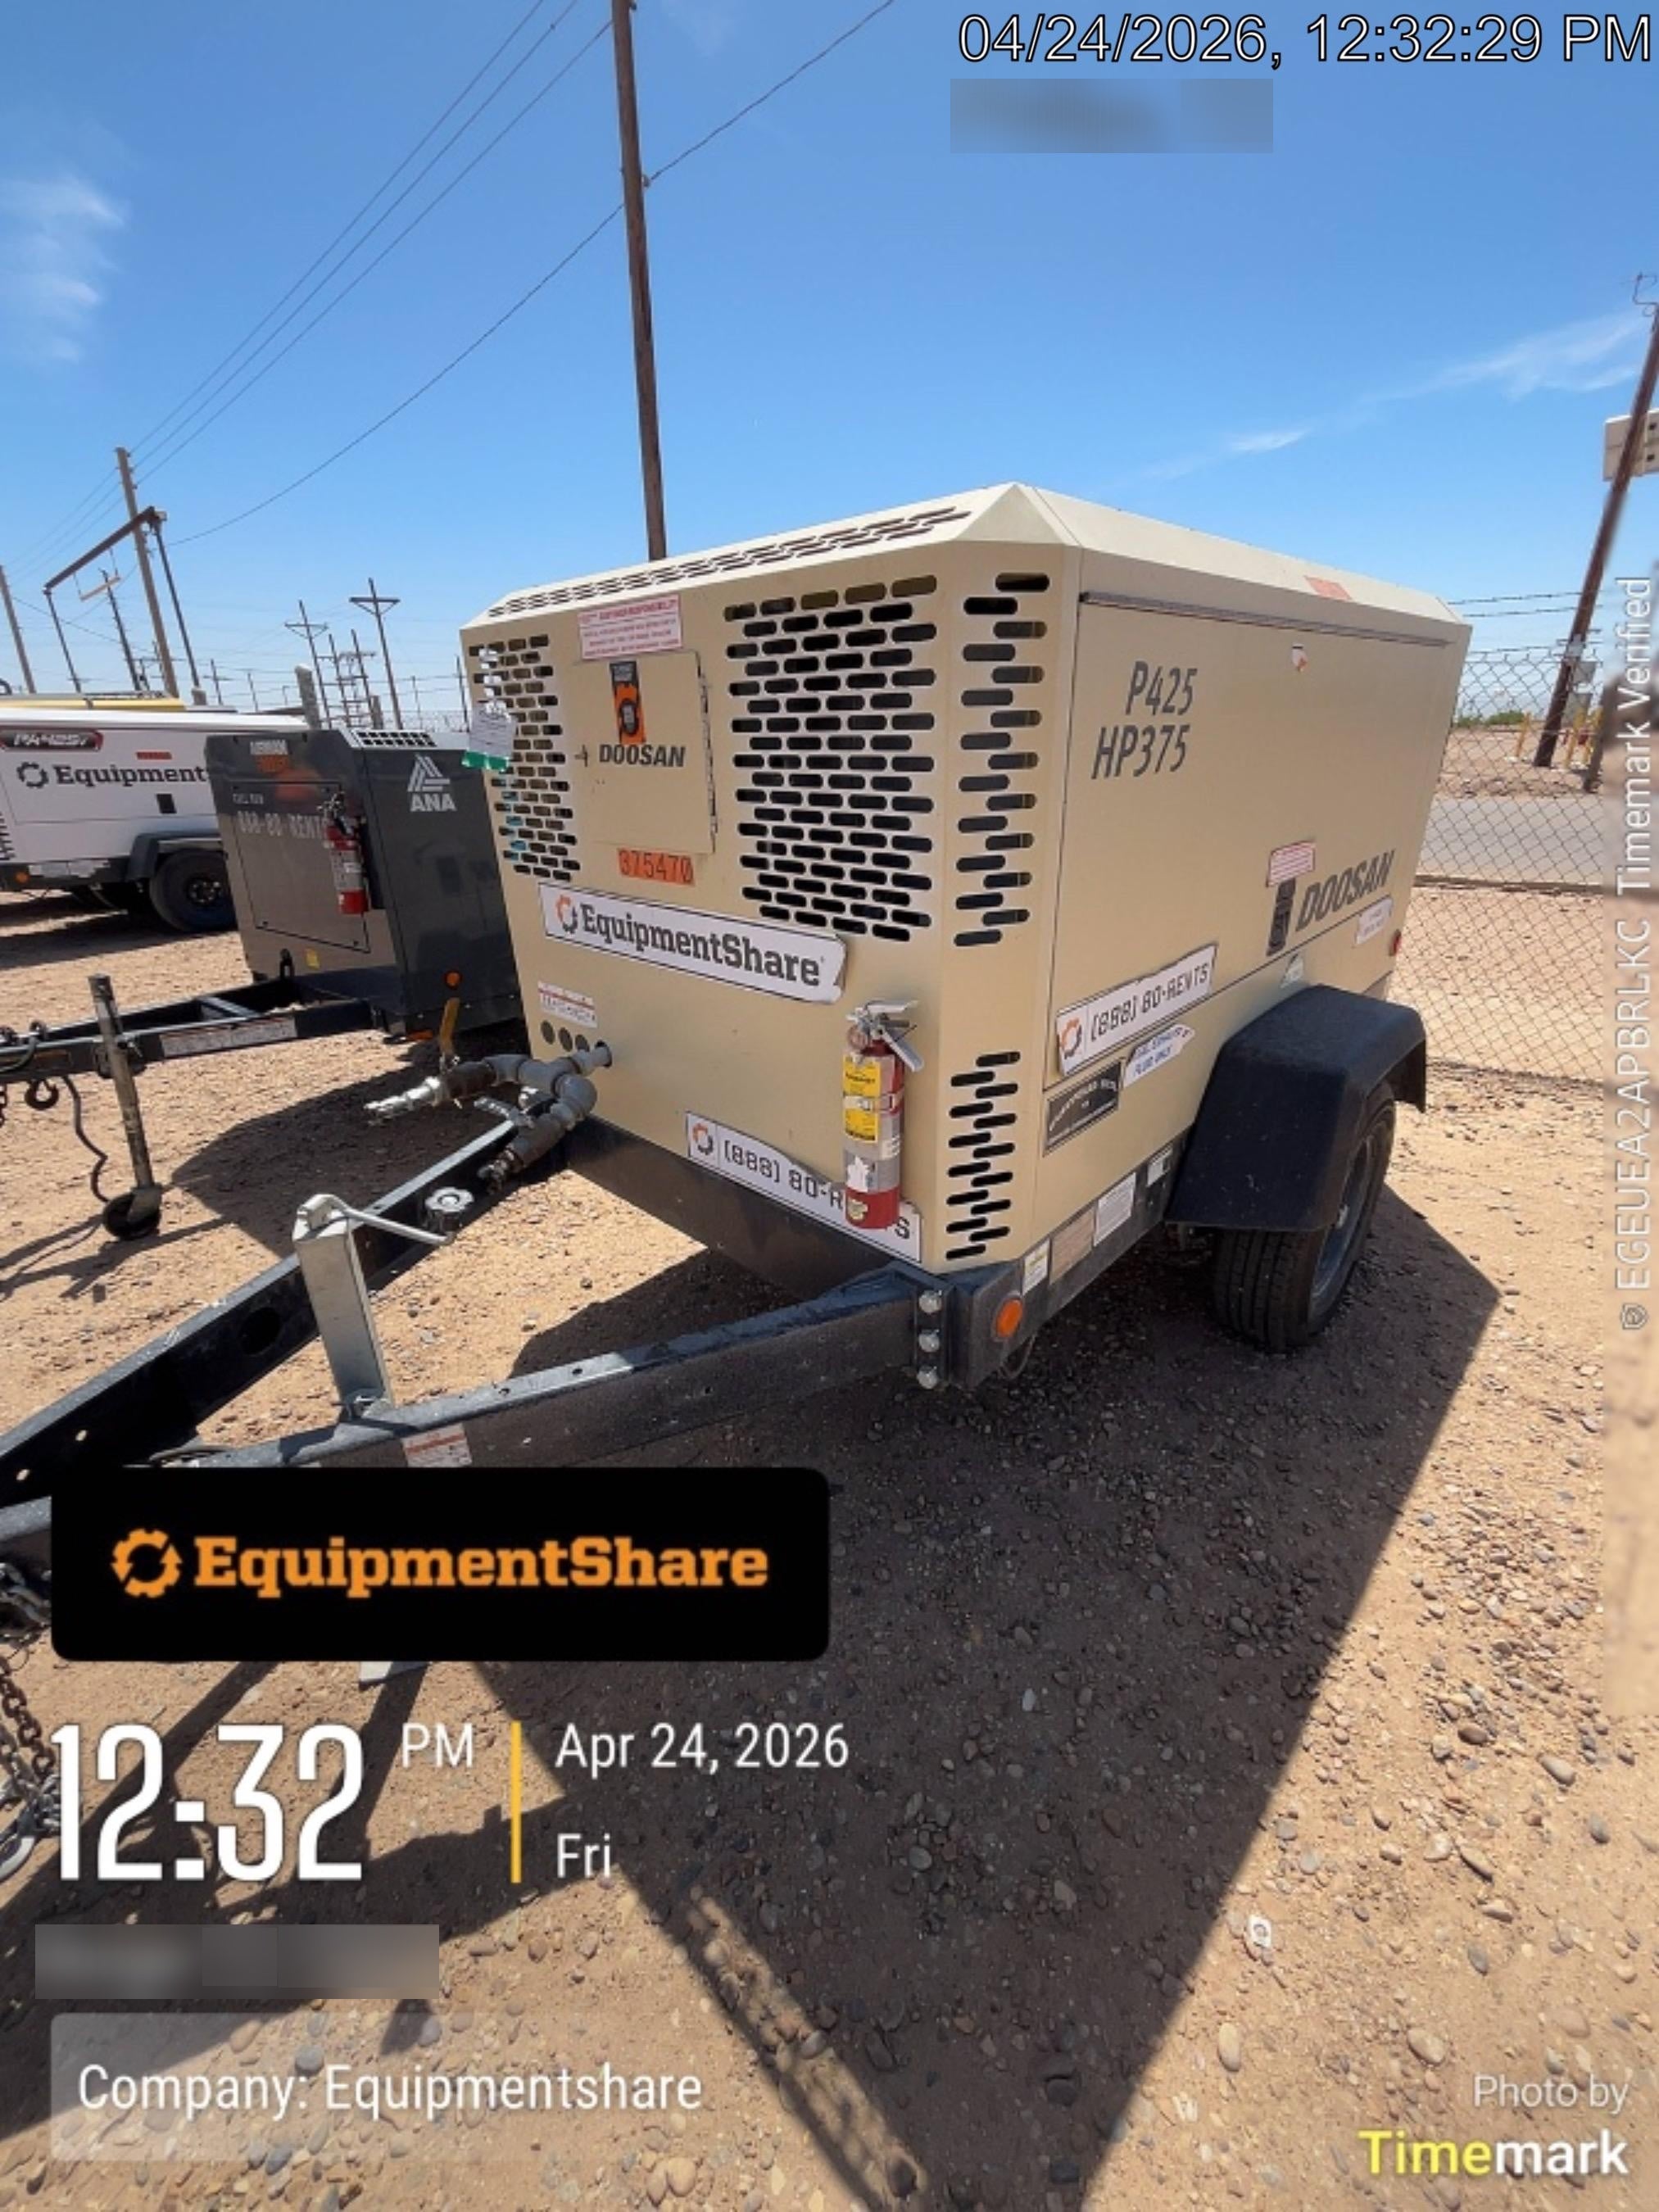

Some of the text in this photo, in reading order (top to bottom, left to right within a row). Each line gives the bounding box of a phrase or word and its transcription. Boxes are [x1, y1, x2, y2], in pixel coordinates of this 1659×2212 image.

[1126, 660, 1198, 716] P425
[52, 764, 208, 787] Equipment
[599, 743, 687, 767] DOOSAN
[1091, 724, 1190, 780] HP375
[410, 793, 456, 812] ANA
[1296, 848, 1395, 931] DOOSAN
[580, 903, 820, 986] EquipmentShare
[724, 1139, 781, 1182] (888)
